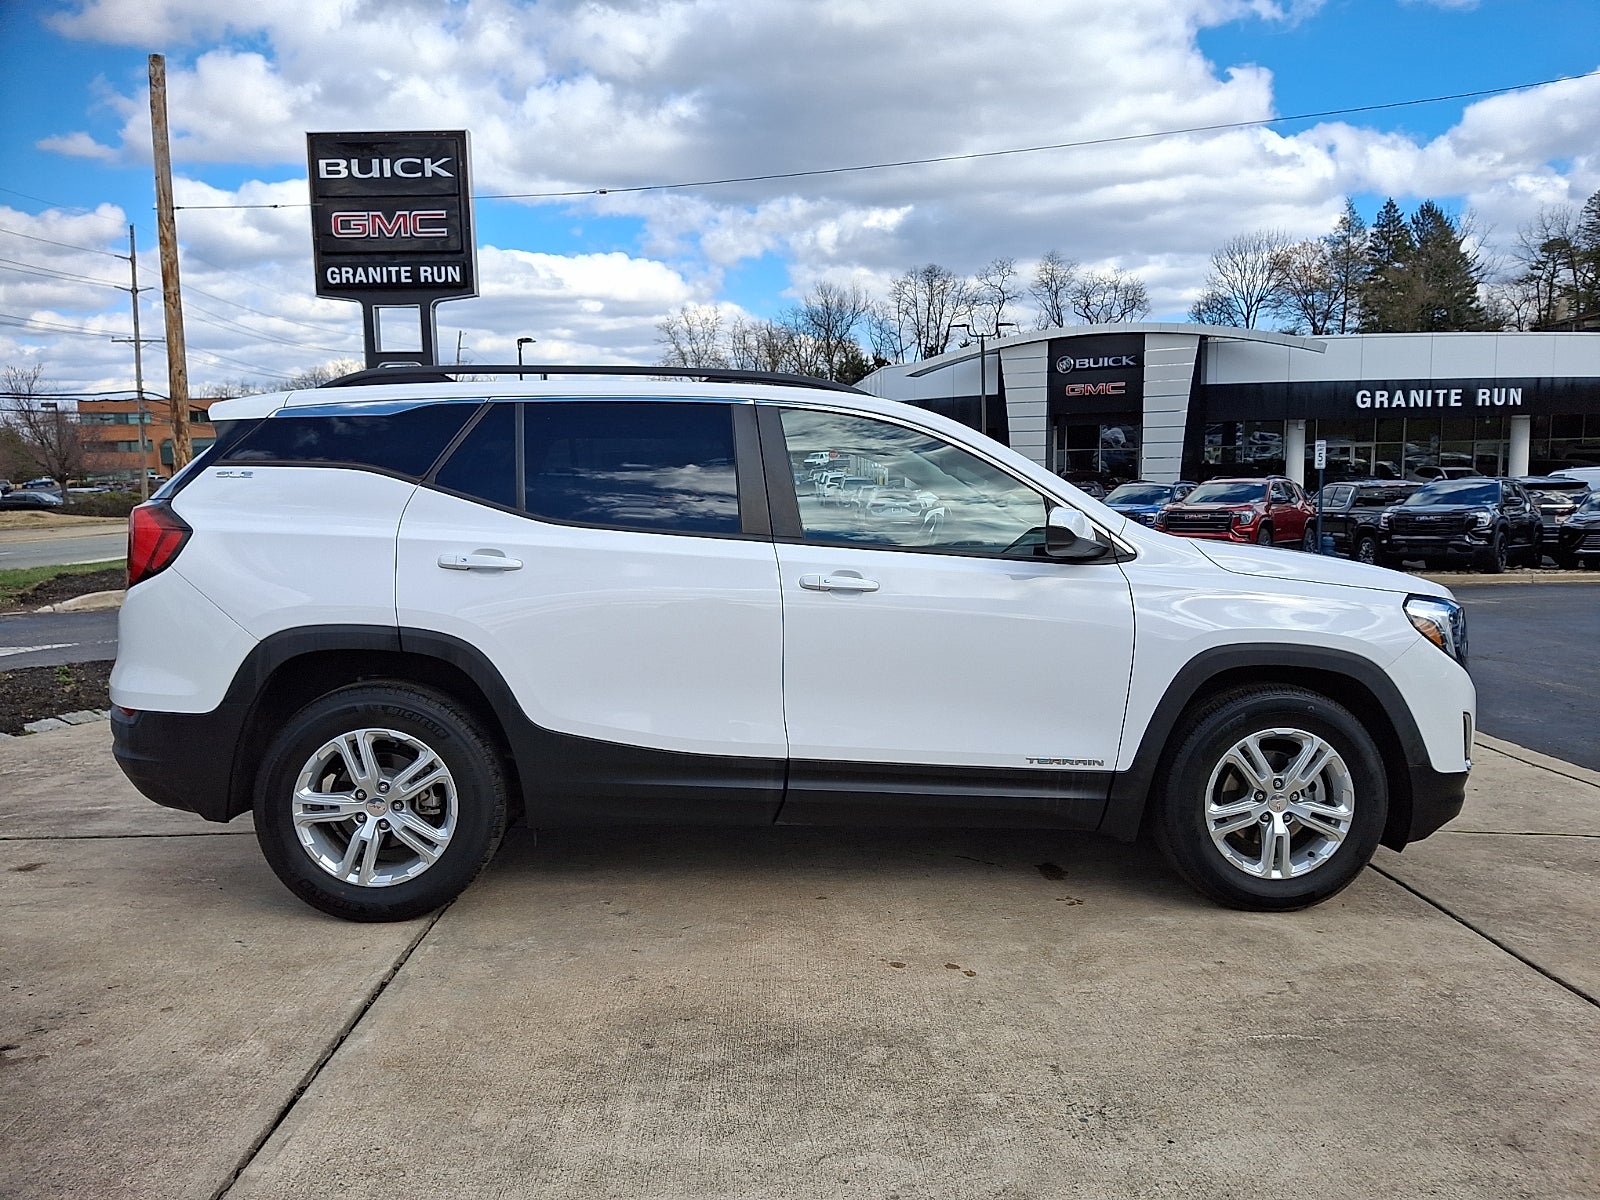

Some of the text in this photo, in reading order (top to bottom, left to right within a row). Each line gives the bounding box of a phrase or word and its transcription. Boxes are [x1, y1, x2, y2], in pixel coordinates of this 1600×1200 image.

[317, 157, 455, 179] BUICK
[331, 209, 449, 238] GMC
[326, 264, 462, 285] GRANITE RUN
[1075, 355, 1137, 369] BUICK
[1065, 381, 1126, 397] GMC
[1355, 387, 1523, 409] GRANITE RUN
[1318, 452, 1324, 462] 5
[1025, 757, 1105, 767] TERRAIN
